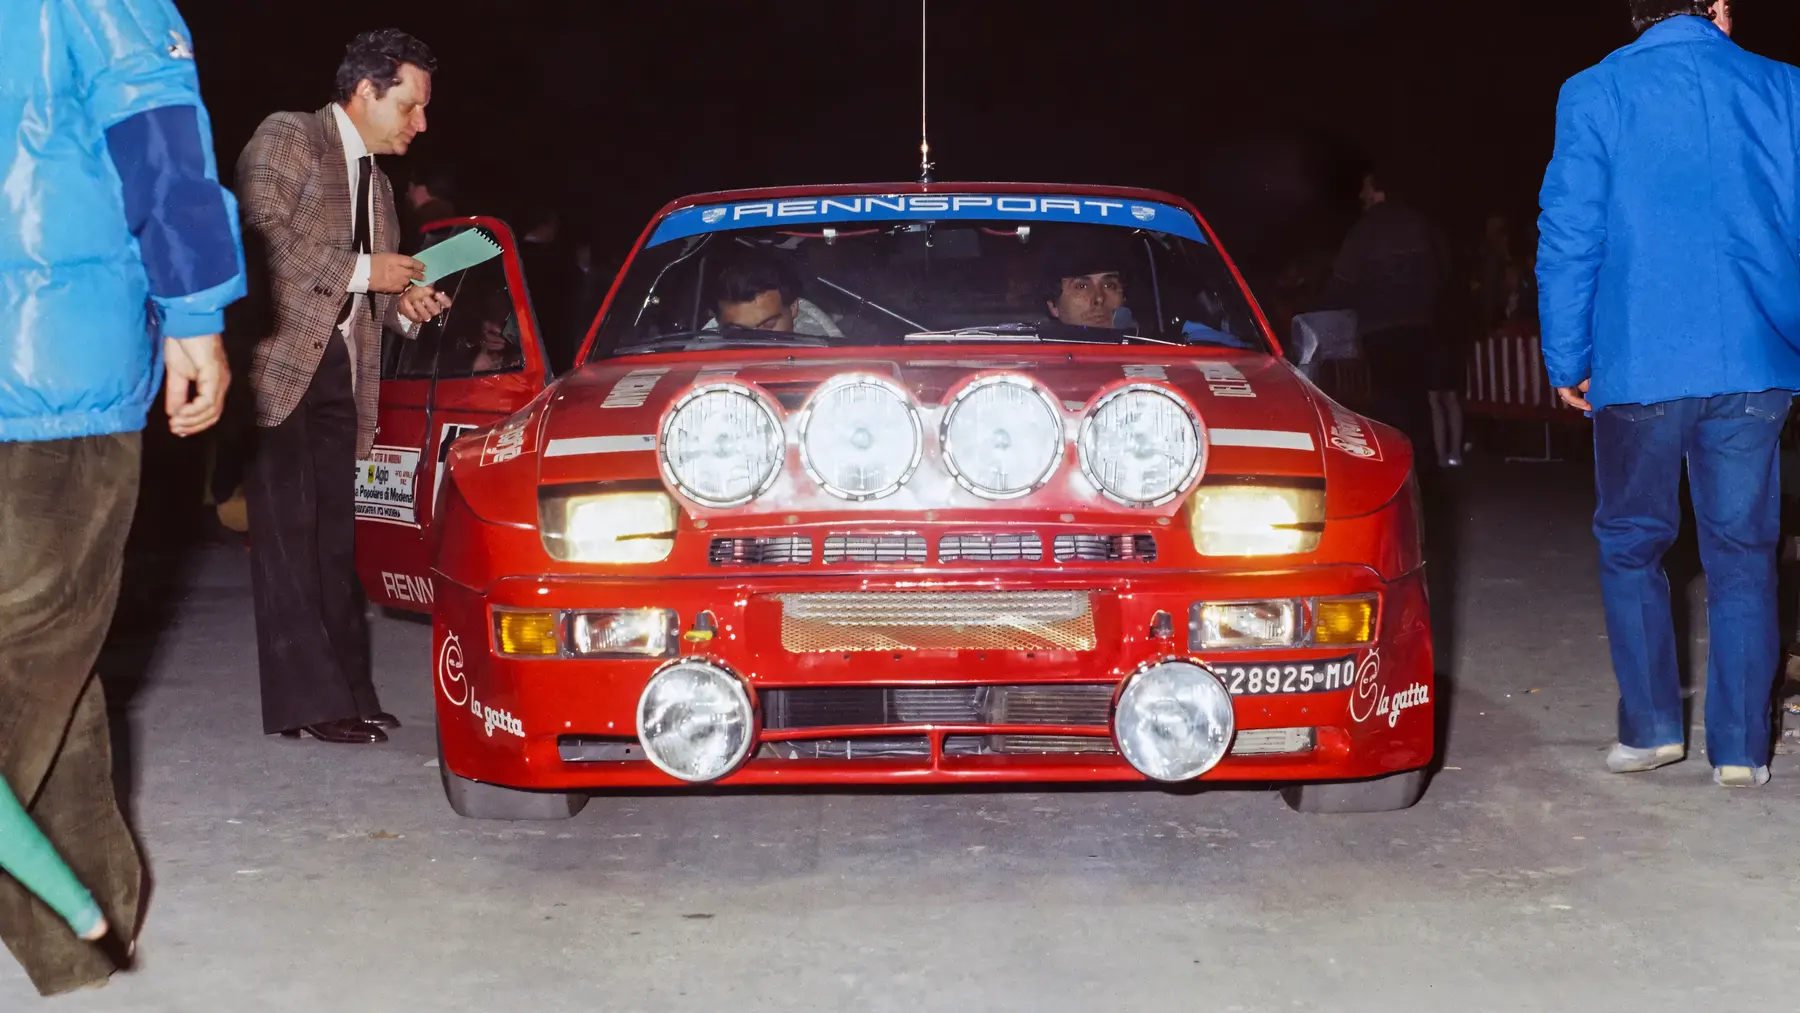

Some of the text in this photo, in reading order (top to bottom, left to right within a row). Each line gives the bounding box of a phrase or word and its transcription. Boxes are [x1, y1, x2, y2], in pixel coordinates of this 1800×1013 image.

[732, 197, 1124, 221] RENNSPORT
[375, 465, 389, 485] Agip
[359, 484, 384, 500] Popolare
[390, 487, 413, 503] Modena
[471, 686, 526, 737] la gatta
[1376, 681, 1430, 728] la gatta
